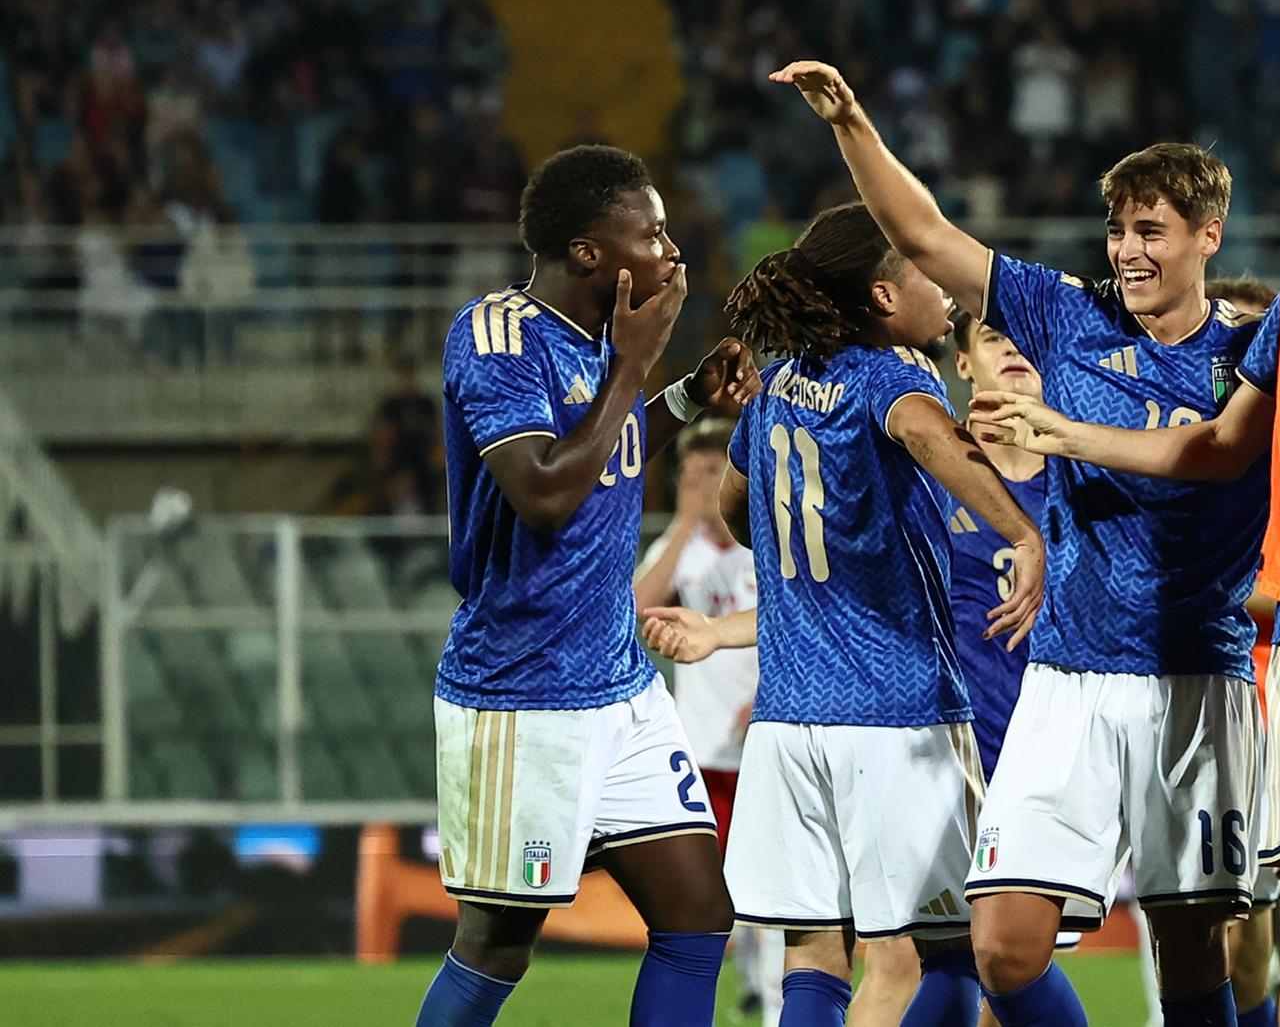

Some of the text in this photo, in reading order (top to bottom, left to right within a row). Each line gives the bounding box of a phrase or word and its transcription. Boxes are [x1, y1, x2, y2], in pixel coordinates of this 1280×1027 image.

[770, 423, 829, 583] 11
[525, 850, 549, 859] ITALIA
[1198, 810, 1245, 875] 16
